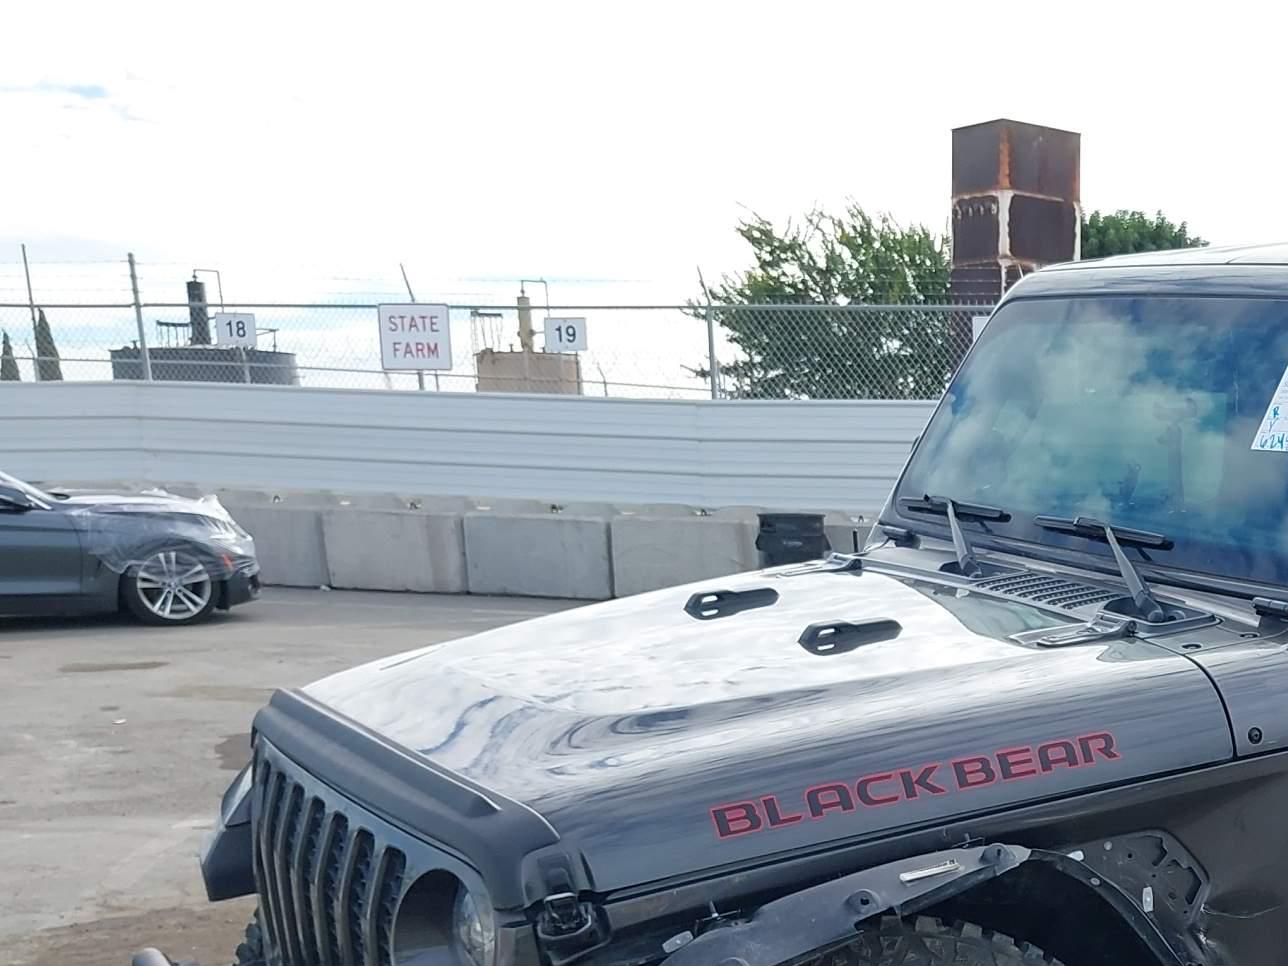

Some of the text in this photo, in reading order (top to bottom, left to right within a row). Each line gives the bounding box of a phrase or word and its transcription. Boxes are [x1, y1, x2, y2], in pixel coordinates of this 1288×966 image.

[225, 320, 246, 338] 18
[388, 314, 440, 334] STATE
[554, 325, 577, 344] 19
[393, 341, 439, 359] FARM
[710, 731, 1121, 840] BLACK BEAR
